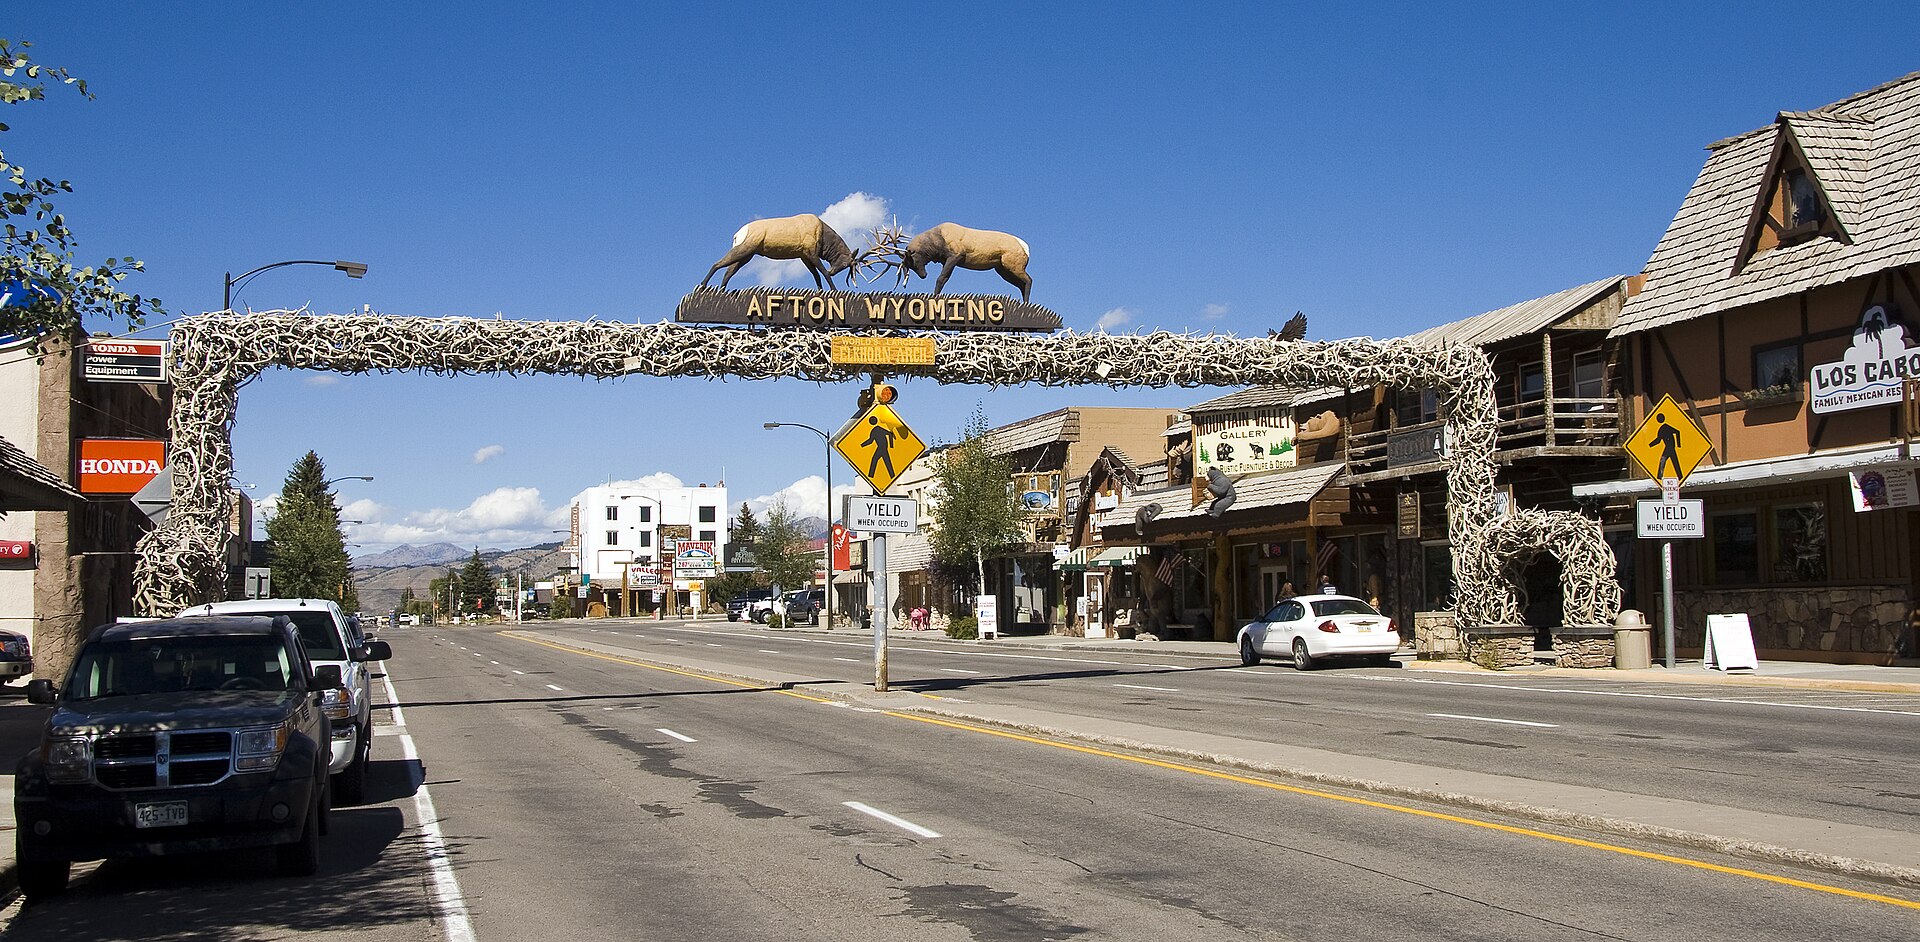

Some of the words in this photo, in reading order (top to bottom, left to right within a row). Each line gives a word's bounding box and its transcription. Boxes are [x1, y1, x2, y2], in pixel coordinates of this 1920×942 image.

[746, 295, 845, 321] AFTON
[864, 297, 1005, 322] WYOMING
[887, 338, 926, 347] LARGEST
[86, 356, 118, 364] Power
[840, 346, 891, 363] ELKHORN
[897, 346, 927, 363] ARCH
[85, 366, 138, 375] Equipment
[1815, 365, 1857, 391] LOS
[1814, 396, 1845, 409] FAMILY
[1846, 389, 1884, 404] MEXICAN
[1886, 386, 1903, 398] RES
[1196, 411, 1250, 437] MOUNTAIN
[1254, 407, 1291, 429] VALLEY
[1220, 429, 1268, 440] GALLERY
[80, 458, 163, 475] HONDA
[1239, 462, 1268, 472] FURNITURE
[866, 502, 902, 517] YIELD
[1653, 506, 1688, 520] YIELD
[857, 518, 876, 527] WHEN
[878, 519, 909, 528] OCCUPIED
[1666, 523, 1696, 531] OCCUPIED
[677, 541, 714, 557] MAVERIK
